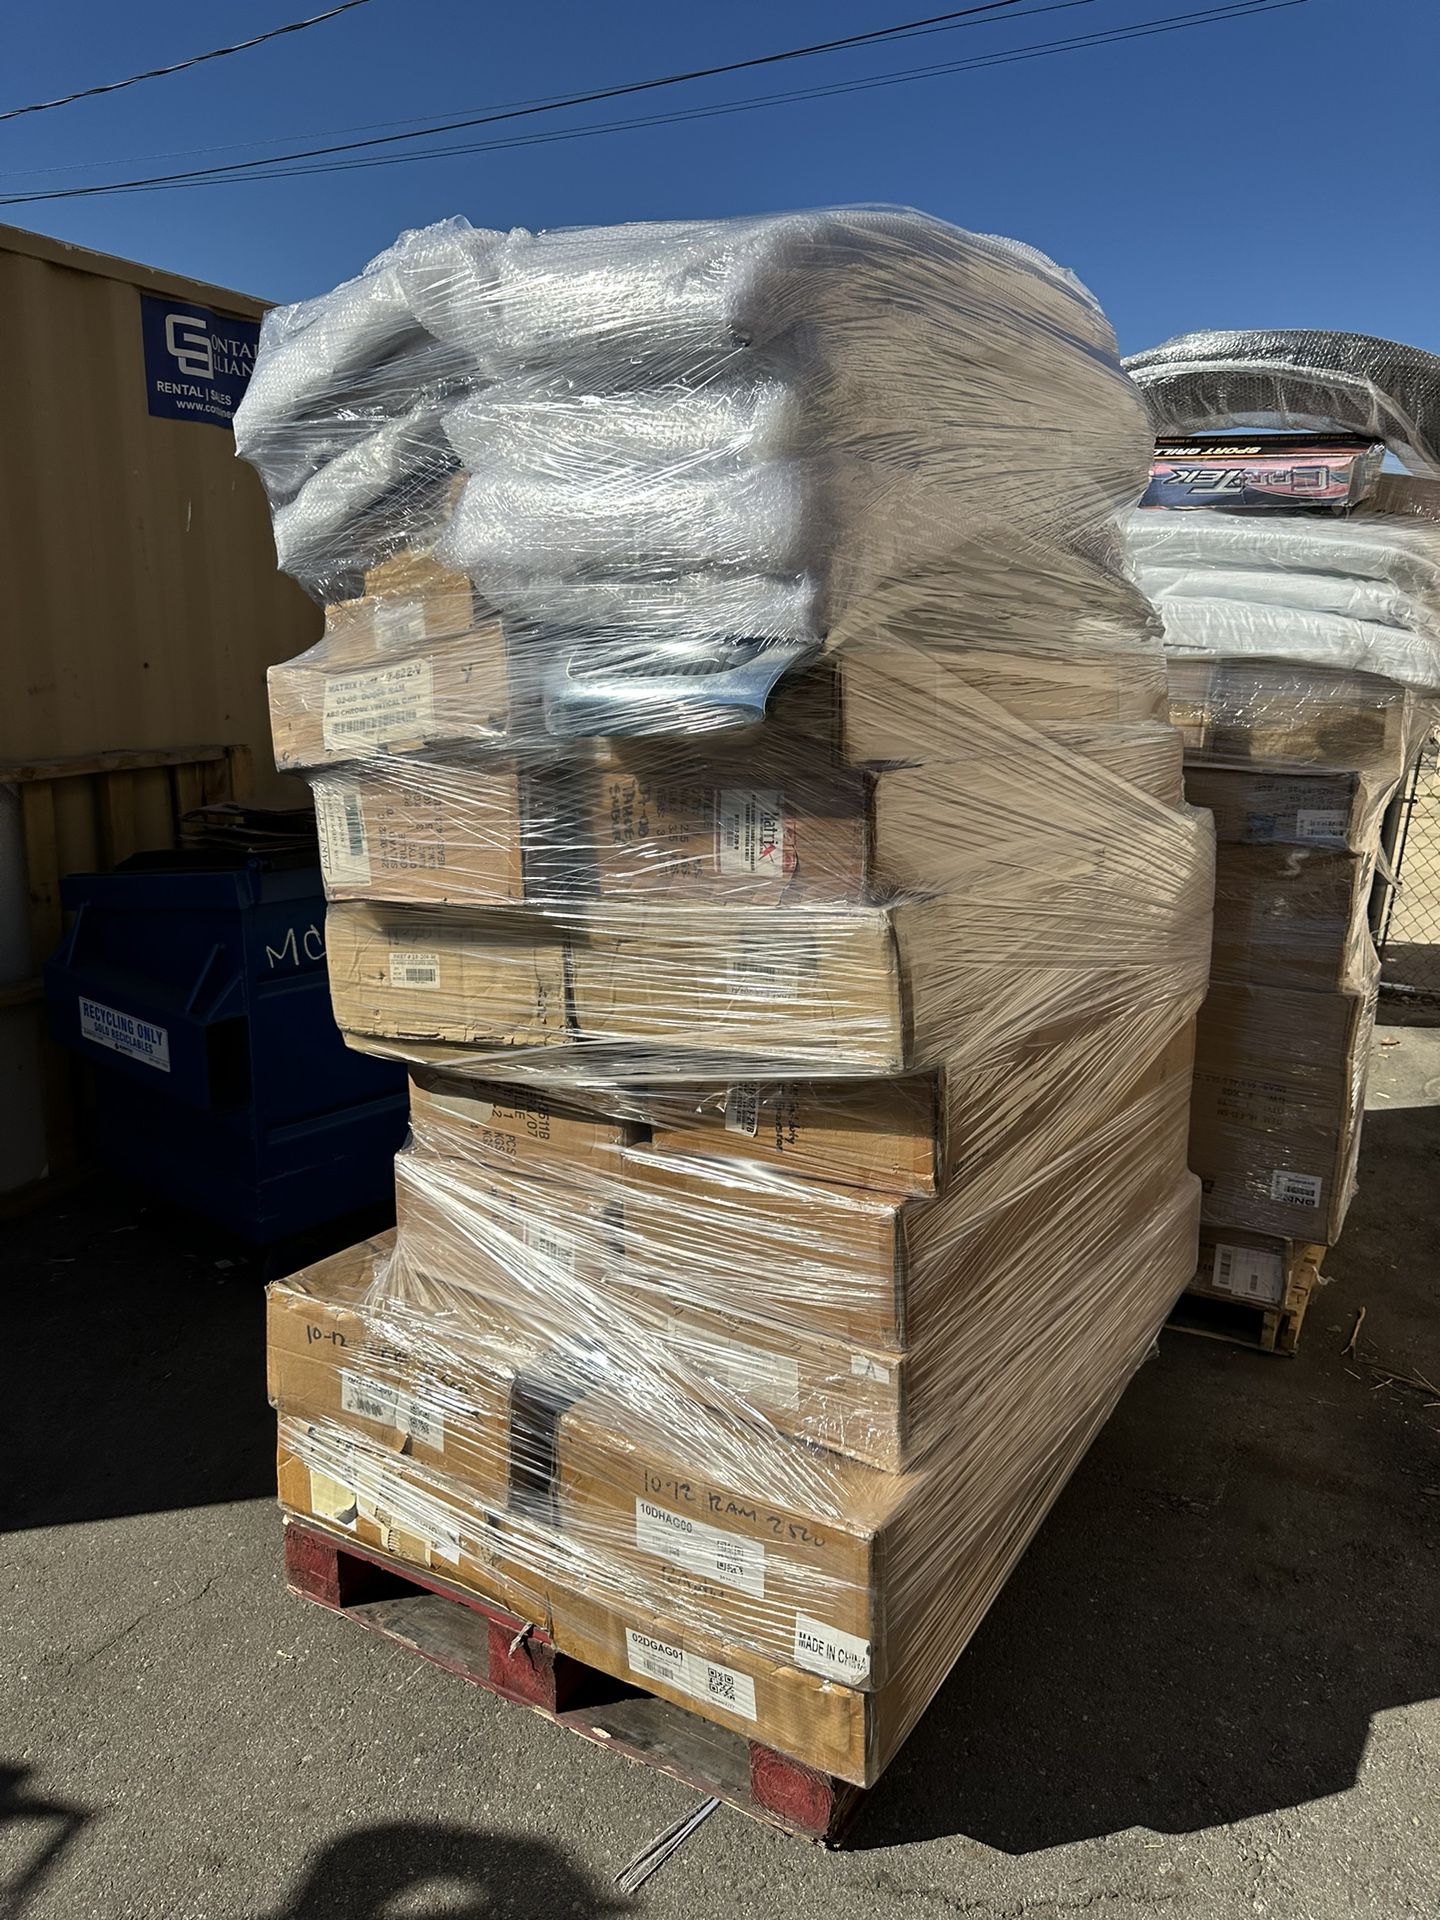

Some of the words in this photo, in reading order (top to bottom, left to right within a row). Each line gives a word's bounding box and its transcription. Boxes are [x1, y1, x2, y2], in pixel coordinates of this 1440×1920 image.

[157, 381, 204, 398] RENTAL
[1200, 446, 1262, 455] SPORT
[83, 1002, 134, 1035] RECYCLING
[137, 1023, 163, 1046] ONLY
[306, 1325, 348, 1348] 10-12
[864, 1359, 877, 1379] A
[640, 1502, 693, 1534] 10DHAG00
[708, 1491, 757, 1522] RAM
[631, 1632, 684, 1661] 02DGAG01
[798, 1631, 825, 1656] MADE
[826, 1643, 836, 1661] IN
[837, 1647, 868, 1672] CHINA
